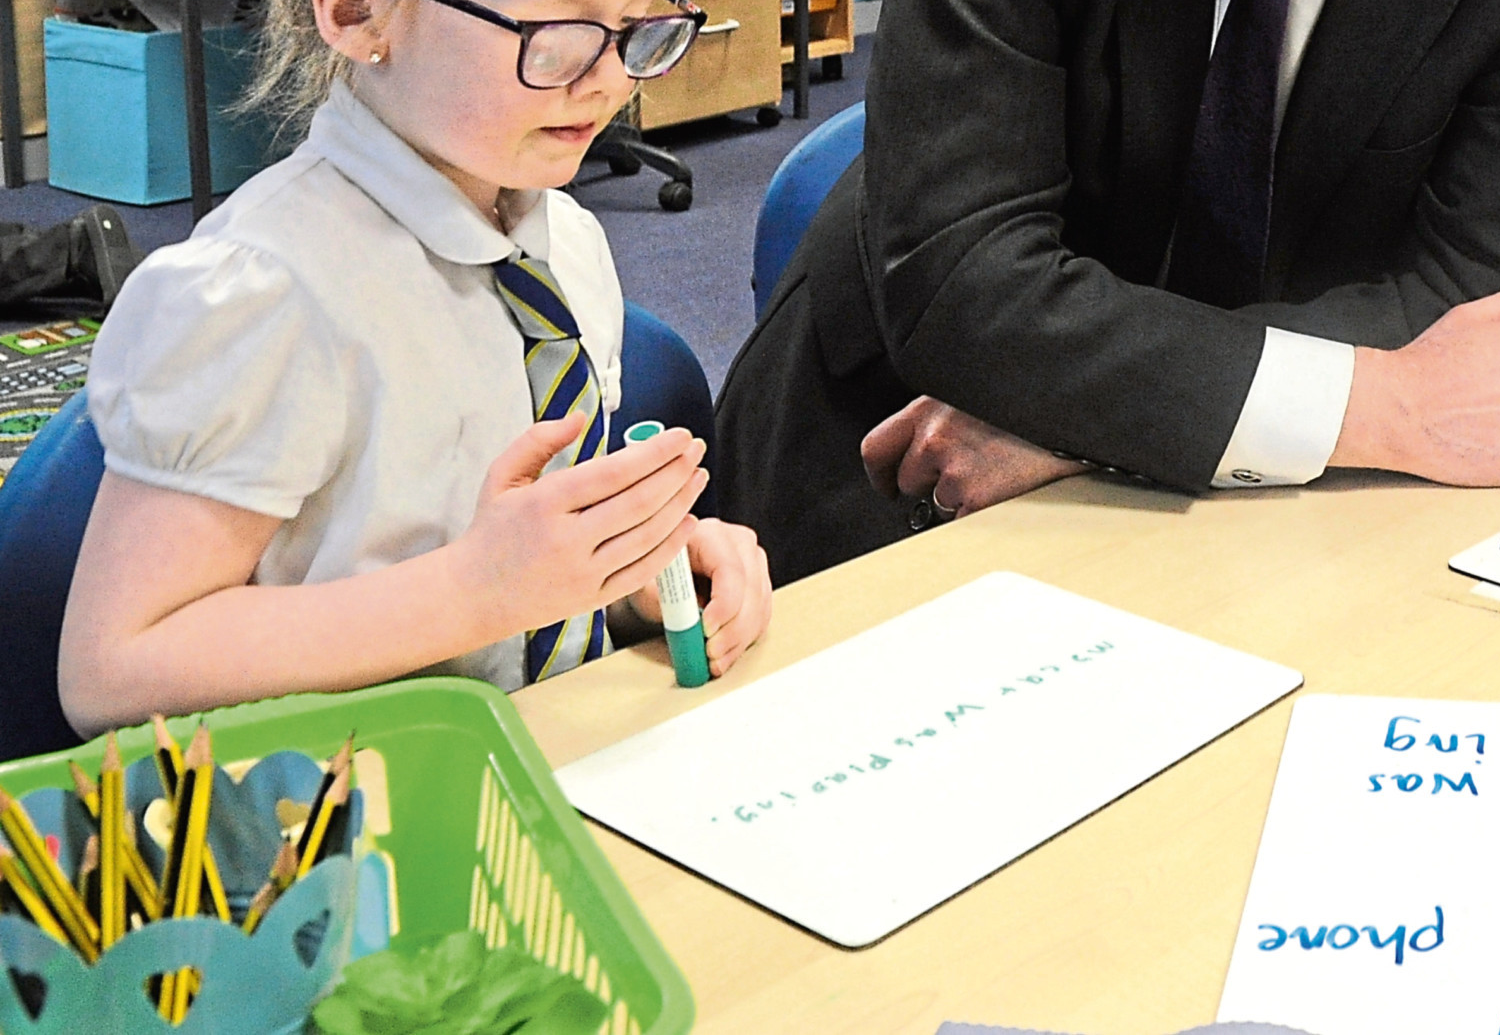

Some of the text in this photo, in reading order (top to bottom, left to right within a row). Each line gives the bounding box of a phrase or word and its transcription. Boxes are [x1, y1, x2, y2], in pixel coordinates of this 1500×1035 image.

[1384, 716, 1486, 766] ing
[1368, 771, 1479, 796] was
[1257, 905, 1445, 966] phone
